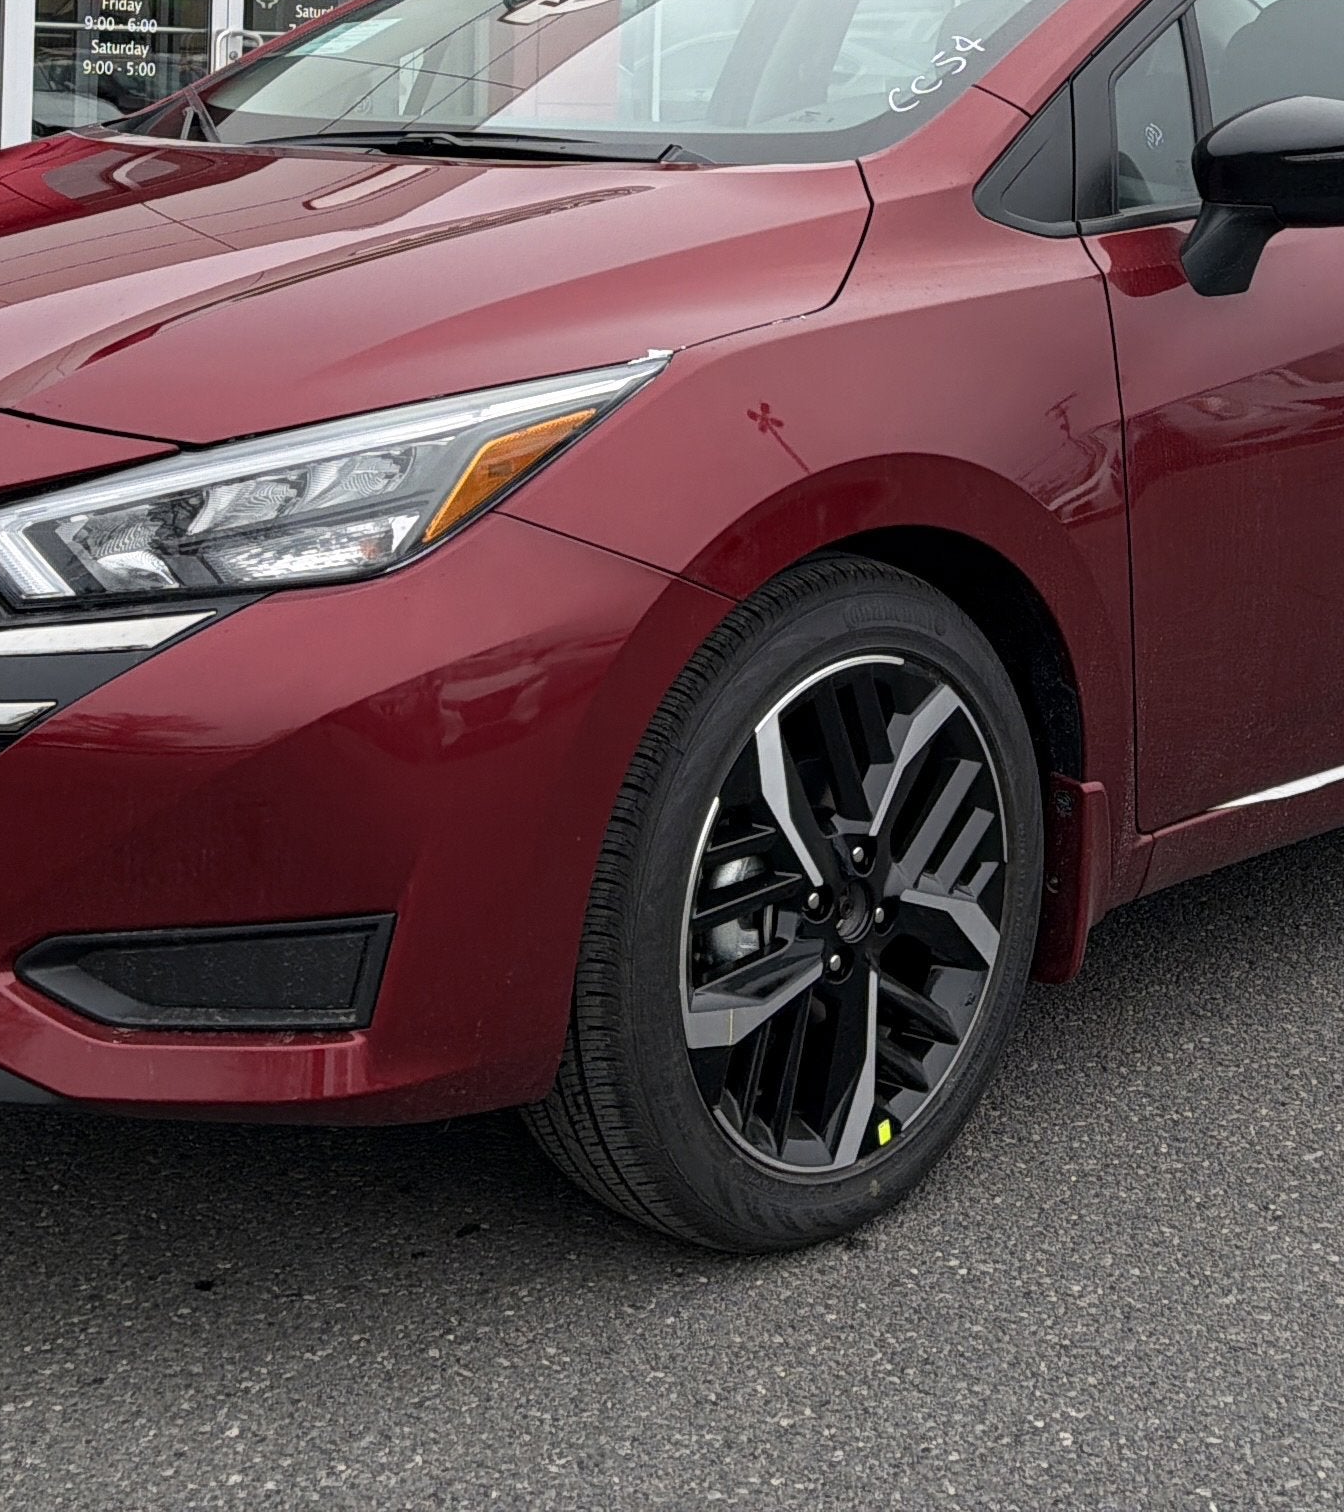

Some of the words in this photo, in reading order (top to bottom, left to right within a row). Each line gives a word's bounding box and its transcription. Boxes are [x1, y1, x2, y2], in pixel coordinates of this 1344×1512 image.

[84, 15, 116, 31] 9:00
[127, 17, 158, 34] 6:00
[90, 39, 150, 58] Saturday
[82, 59, 114, 75] 9:00
[126, 61, 157, 77] 5:00
